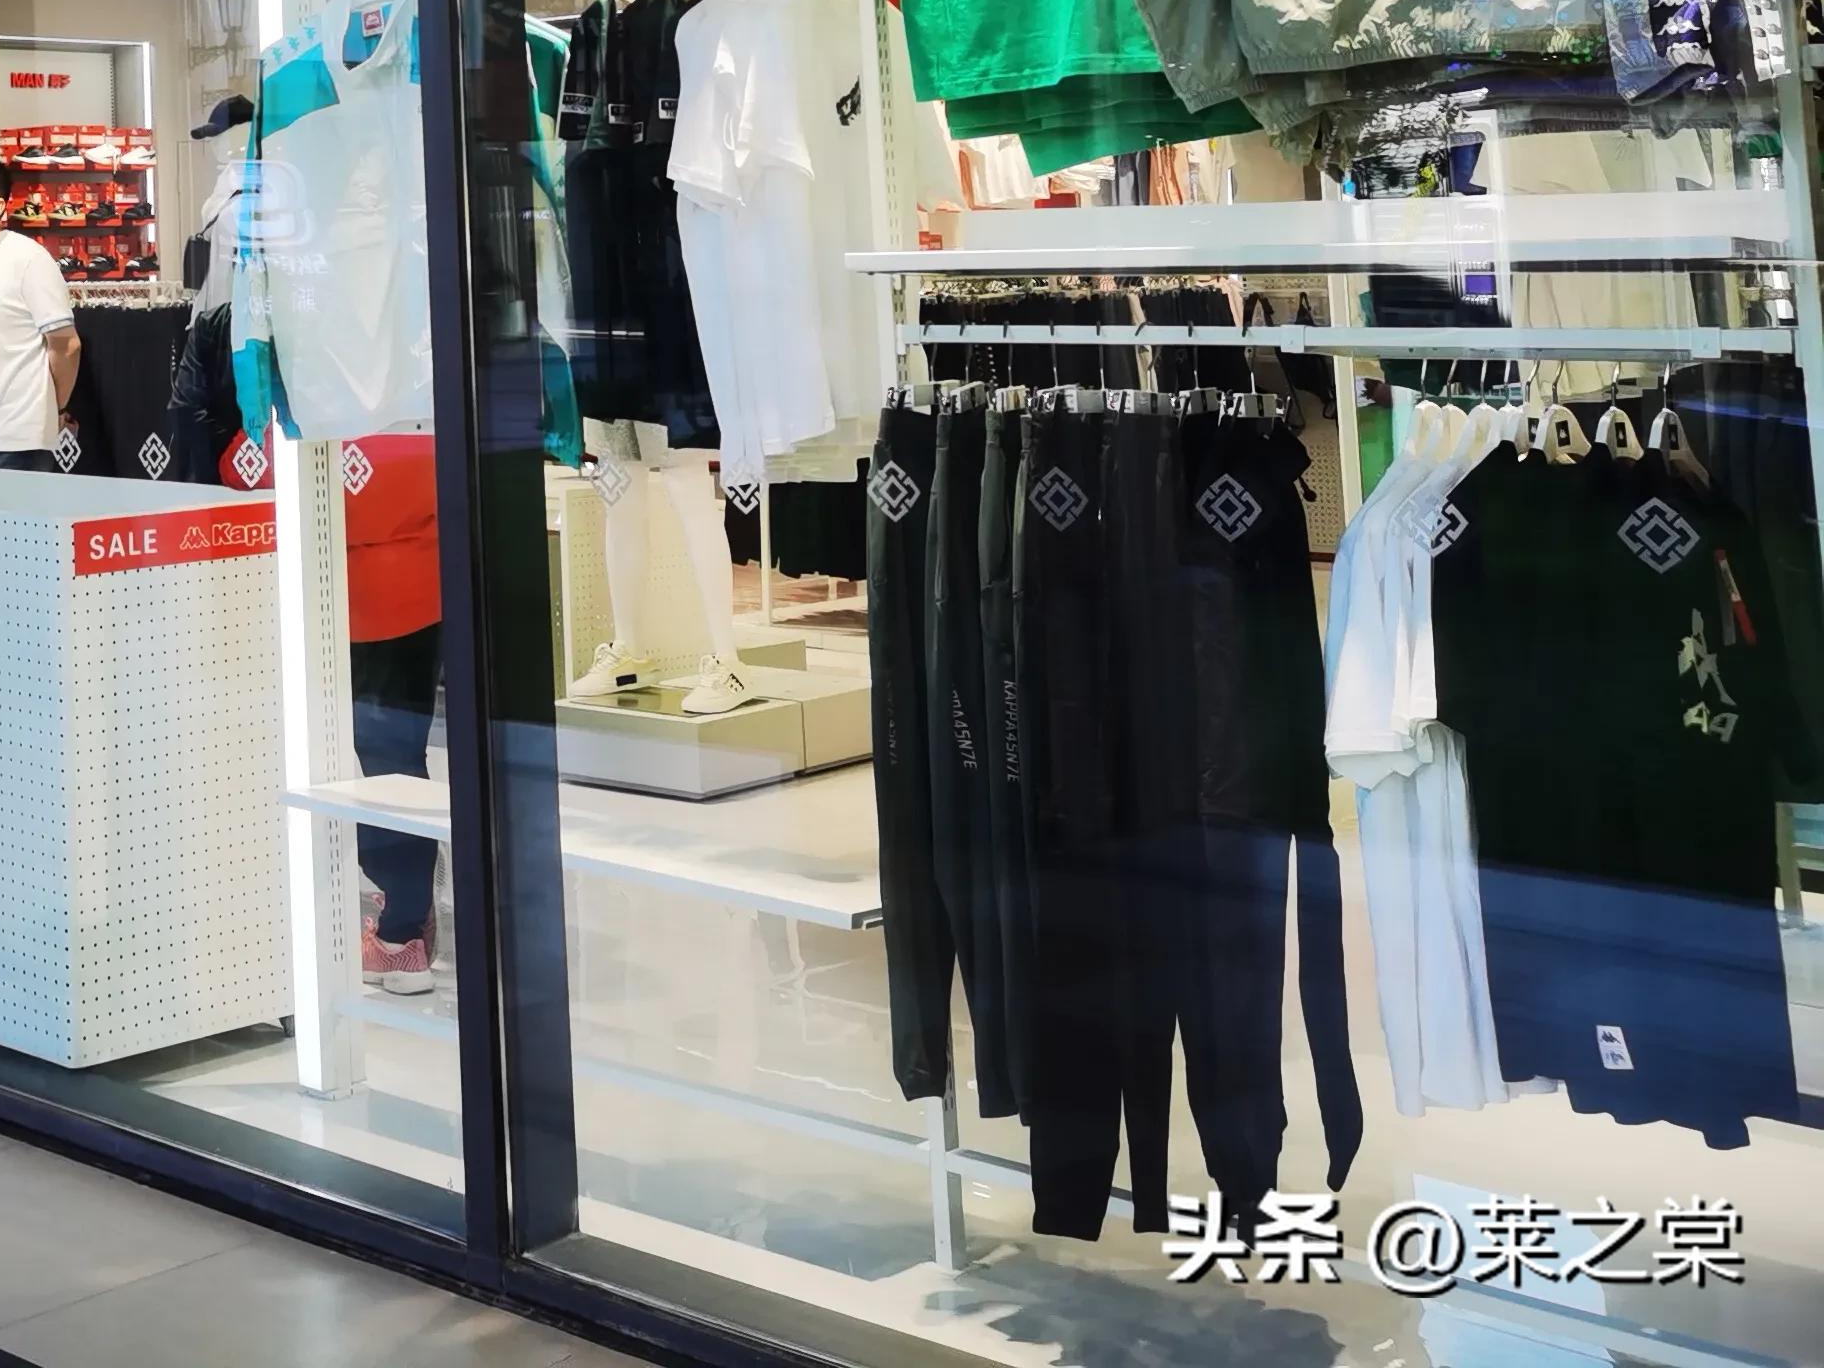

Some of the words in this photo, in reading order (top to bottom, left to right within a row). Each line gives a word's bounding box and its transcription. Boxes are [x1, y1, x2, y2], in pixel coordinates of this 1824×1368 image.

[11, 72, 44, 88] MAN
[89, 528, 158, 560] SALE
[211, 521, 277, 547] Kapp
